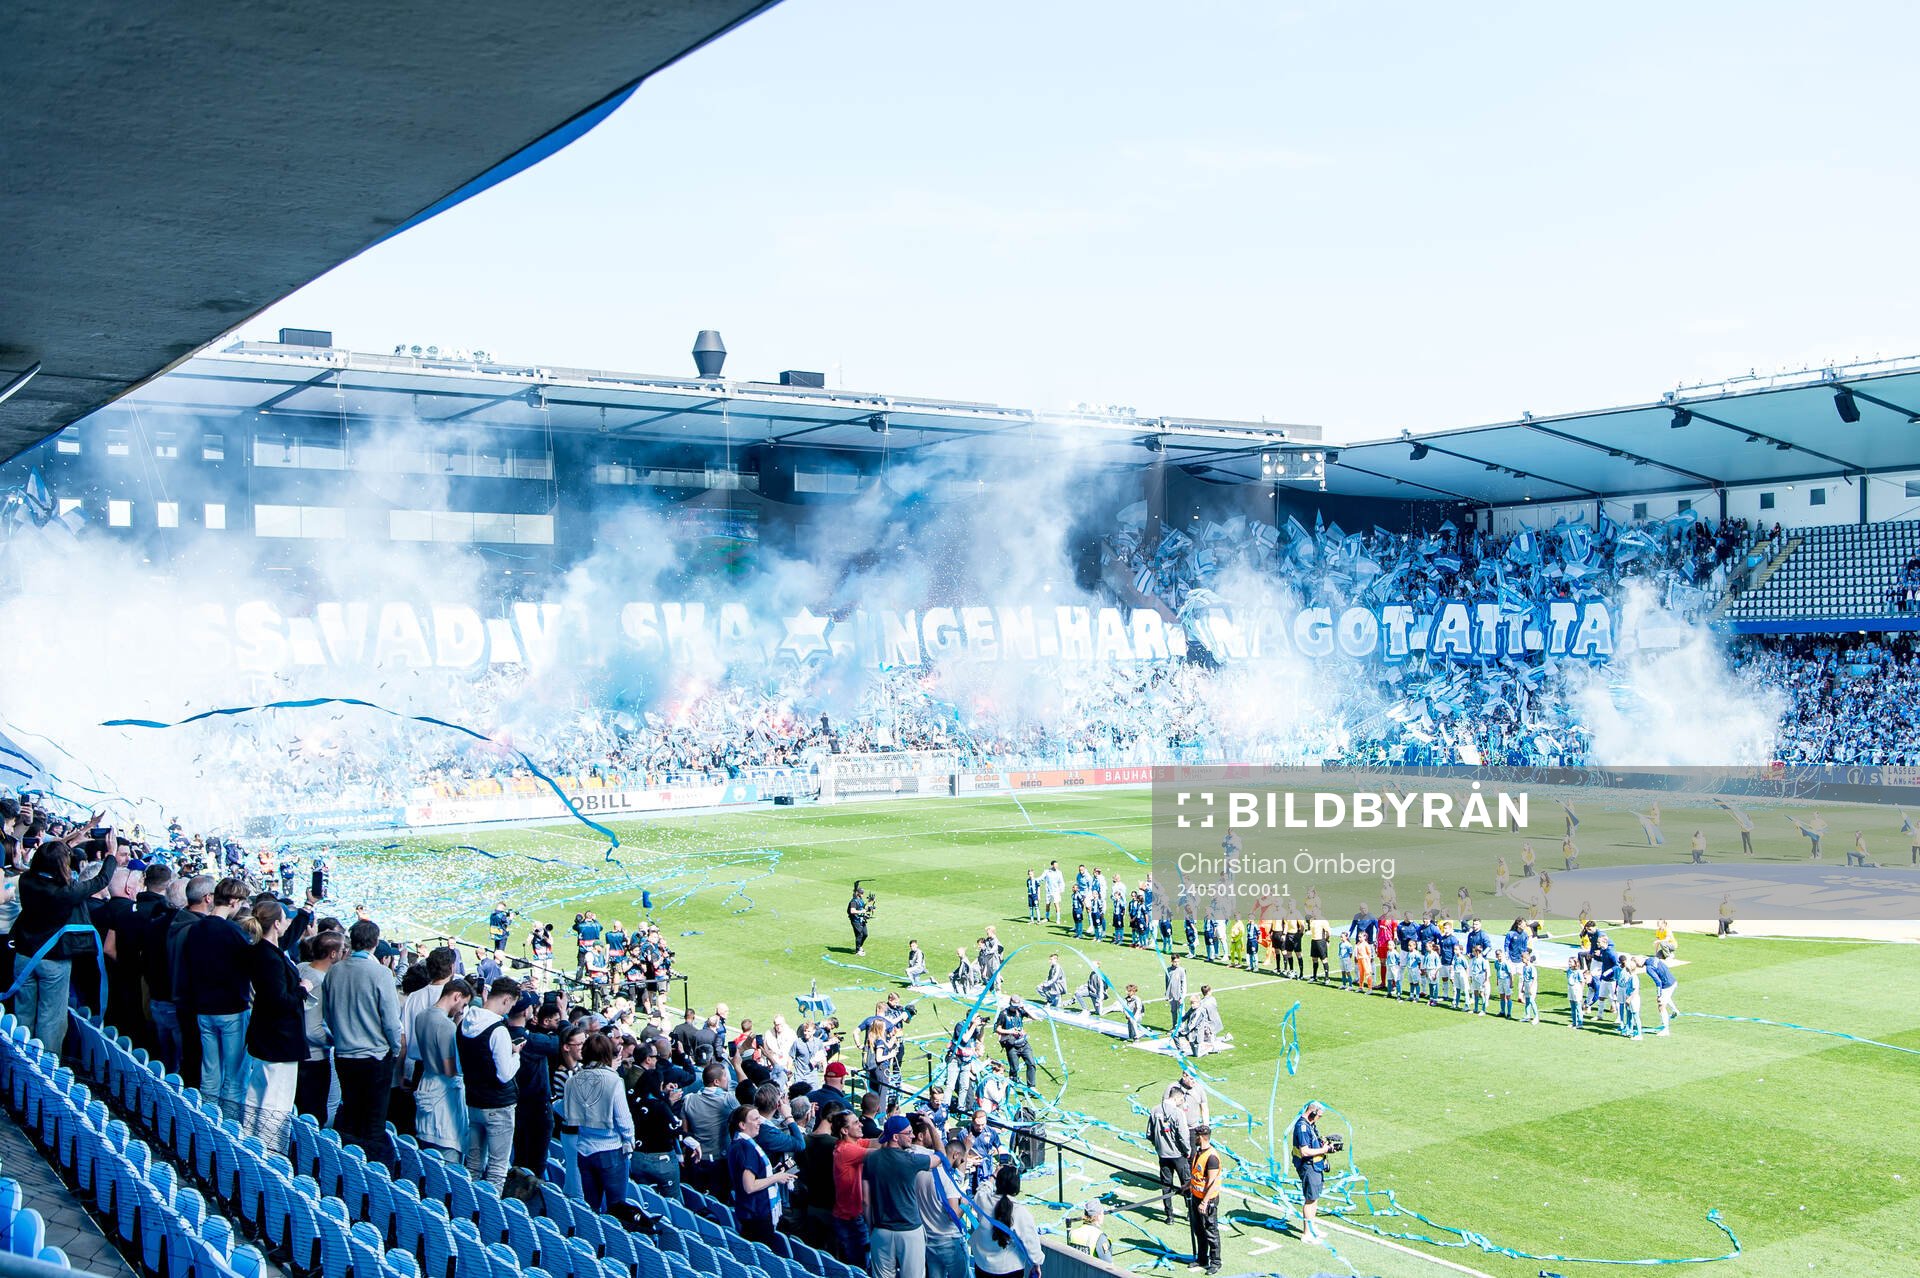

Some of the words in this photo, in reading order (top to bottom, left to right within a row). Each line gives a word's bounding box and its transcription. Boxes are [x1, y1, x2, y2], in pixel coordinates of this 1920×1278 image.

[315, 602, 486, 667] VAD
[1056, 606, 1169, 660] HAR
[1432, 603, 1531, 655] ATT
[1104, 767, 1166, 782] BAUHAUS
[558, 793, 632, 812] OBILL
